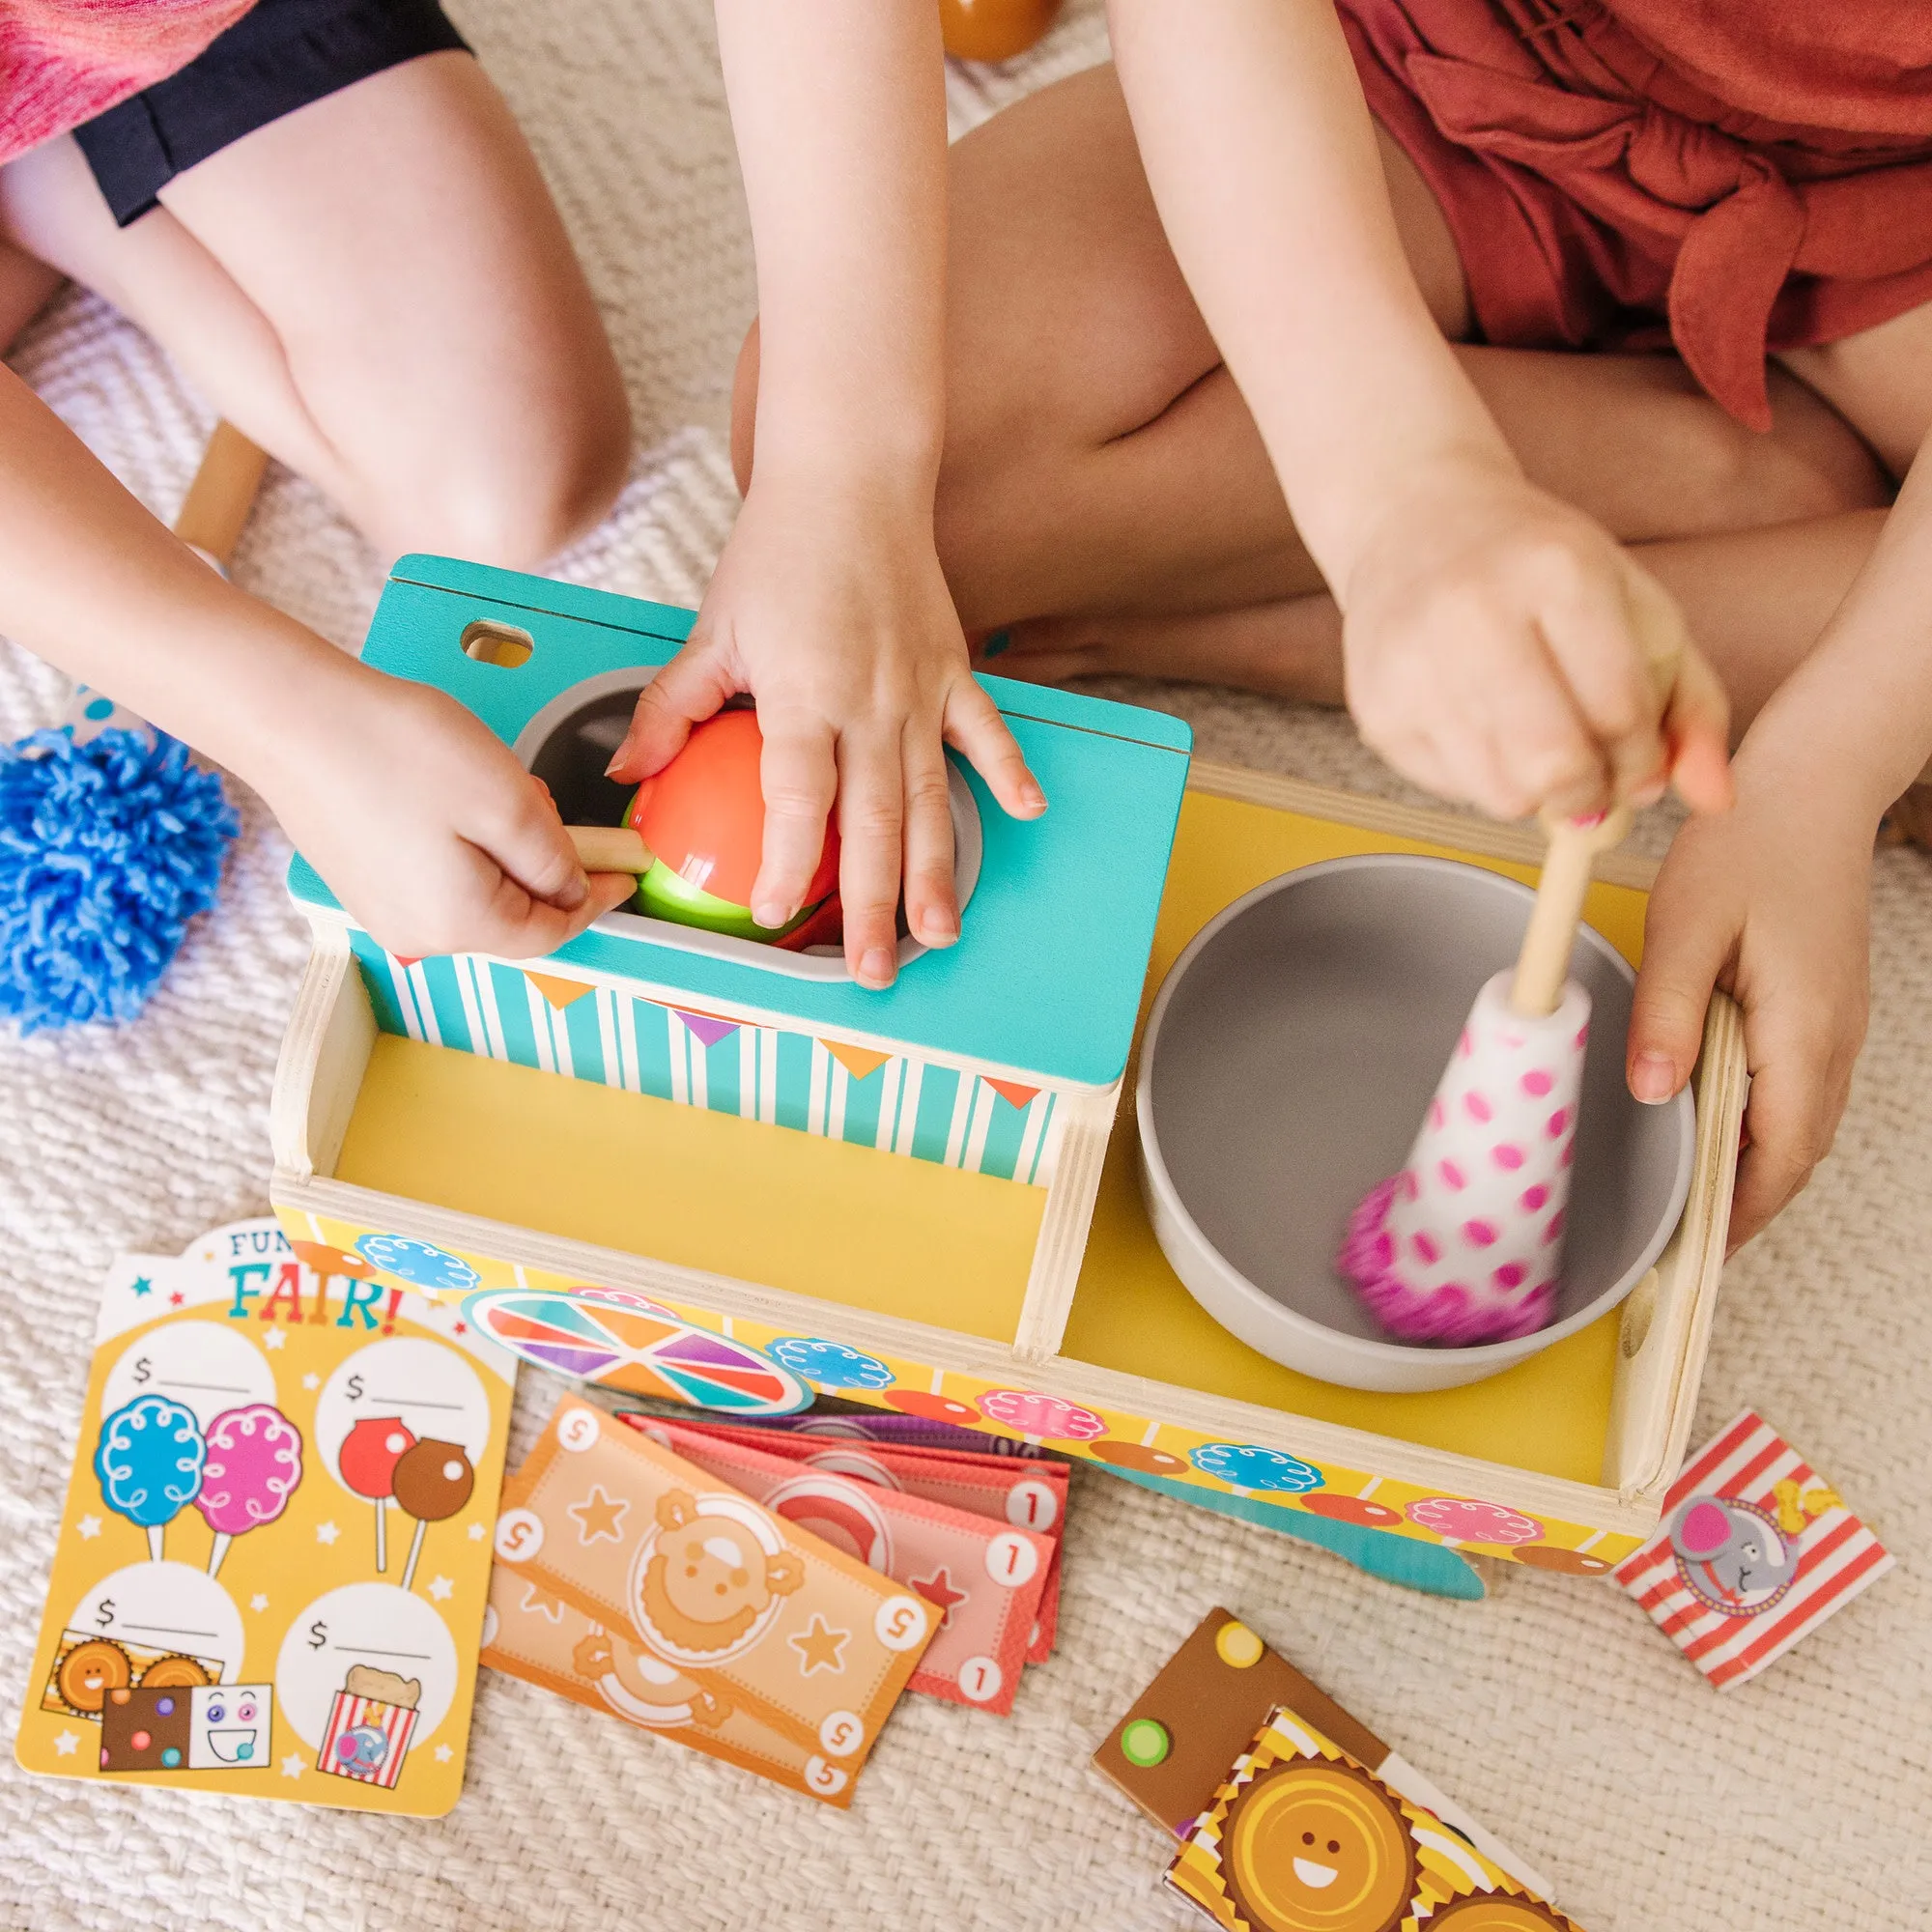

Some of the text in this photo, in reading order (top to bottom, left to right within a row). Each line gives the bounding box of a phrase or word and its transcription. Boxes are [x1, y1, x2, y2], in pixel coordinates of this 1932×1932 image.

[228, 1263, 404, 1335] FAIR!
[133, 1357, 152, 1384] $
[346, 1375, 363, 1402] $
[567, 1419, 588, 1443] 5
[1026, 1492, 1038, 1523] 1
[502, 1521, 533, 1551] 5
[1008, 1545, 1020, 1575] 1
[96, 1599, 116, 1628] $
[886, 1607, 916, 1639] 5
[308, 1620, 327, 1650] $
[976, 1666, 986, 1693] 1
[830, 1722, 854, 1747] 5
[814, 1760, 838, 1787] 5
